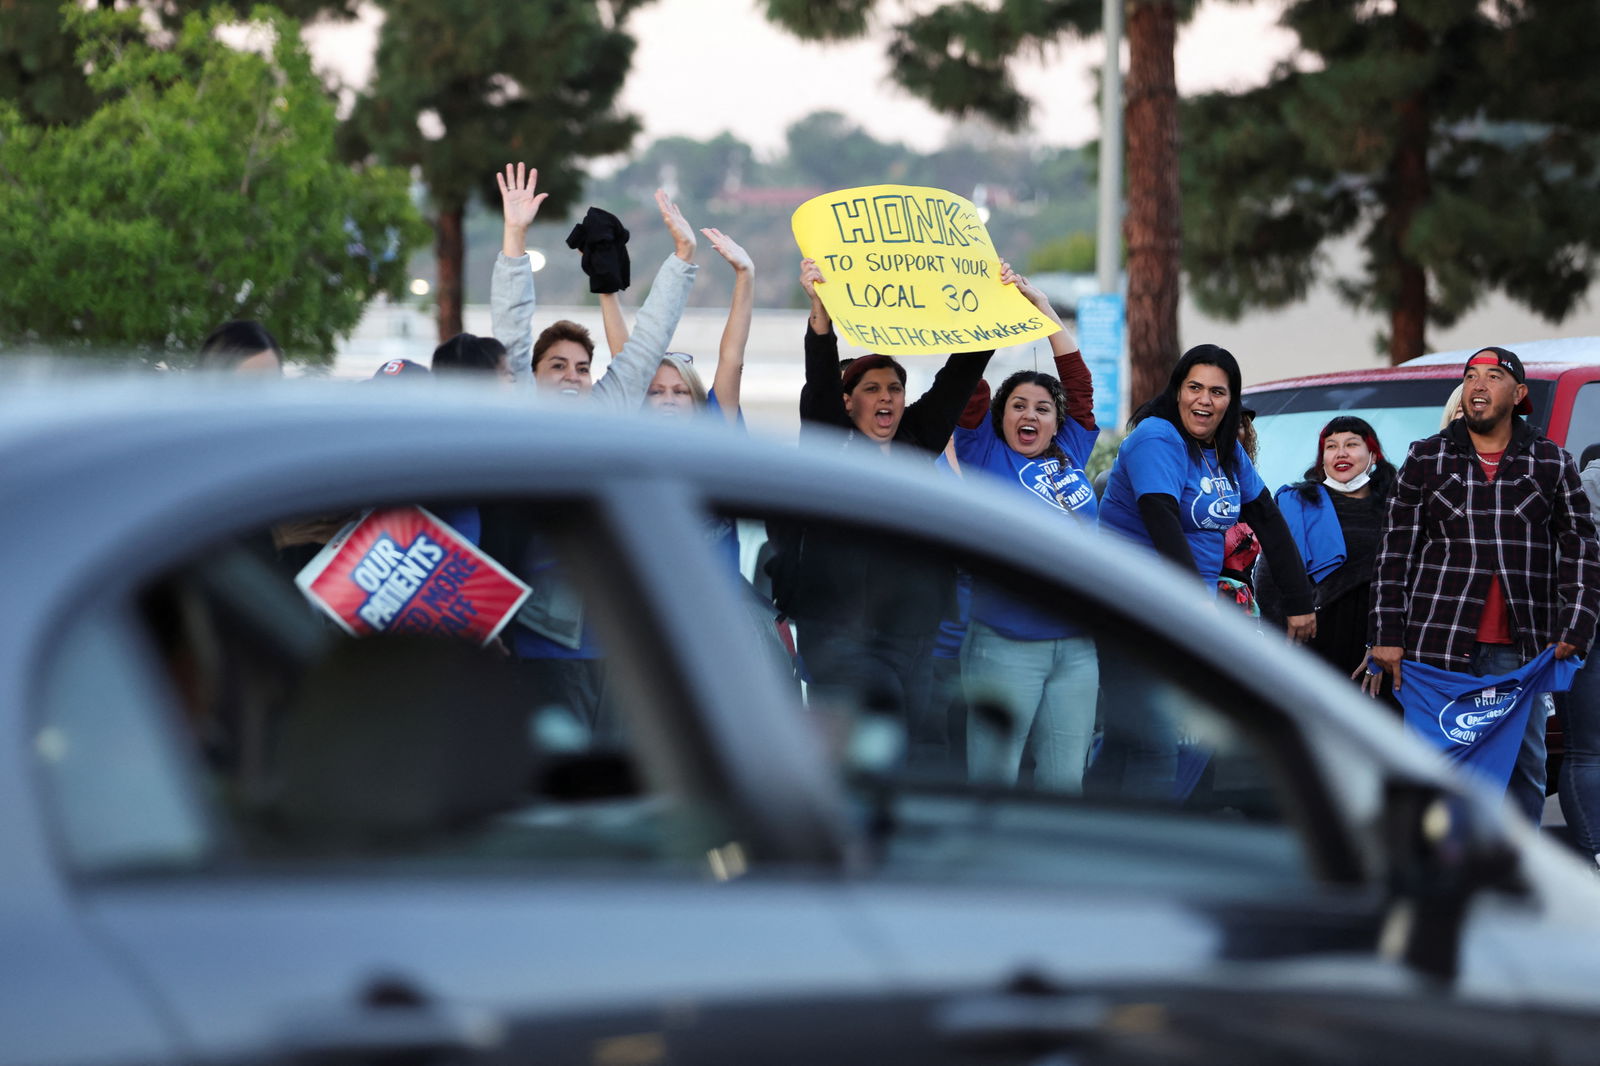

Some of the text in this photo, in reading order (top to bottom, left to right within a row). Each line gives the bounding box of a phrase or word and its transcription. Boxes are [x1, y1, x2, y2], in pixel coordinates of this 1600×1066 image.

[831, 194, 970, 247] HONK
[824, 252, 990, 279] TO SUPPORT YOUR
[846, 283, 979, 312] LOCAL 30
[836, 316, 1044, 346] HEALTHCARE WORKERS
[354, 538, 405, 593] OUR
[359, 535, 443, 632] PATIENTS
[420, 552, 478, 613] MORE
[1474, 695, 1506, 708] PROU
